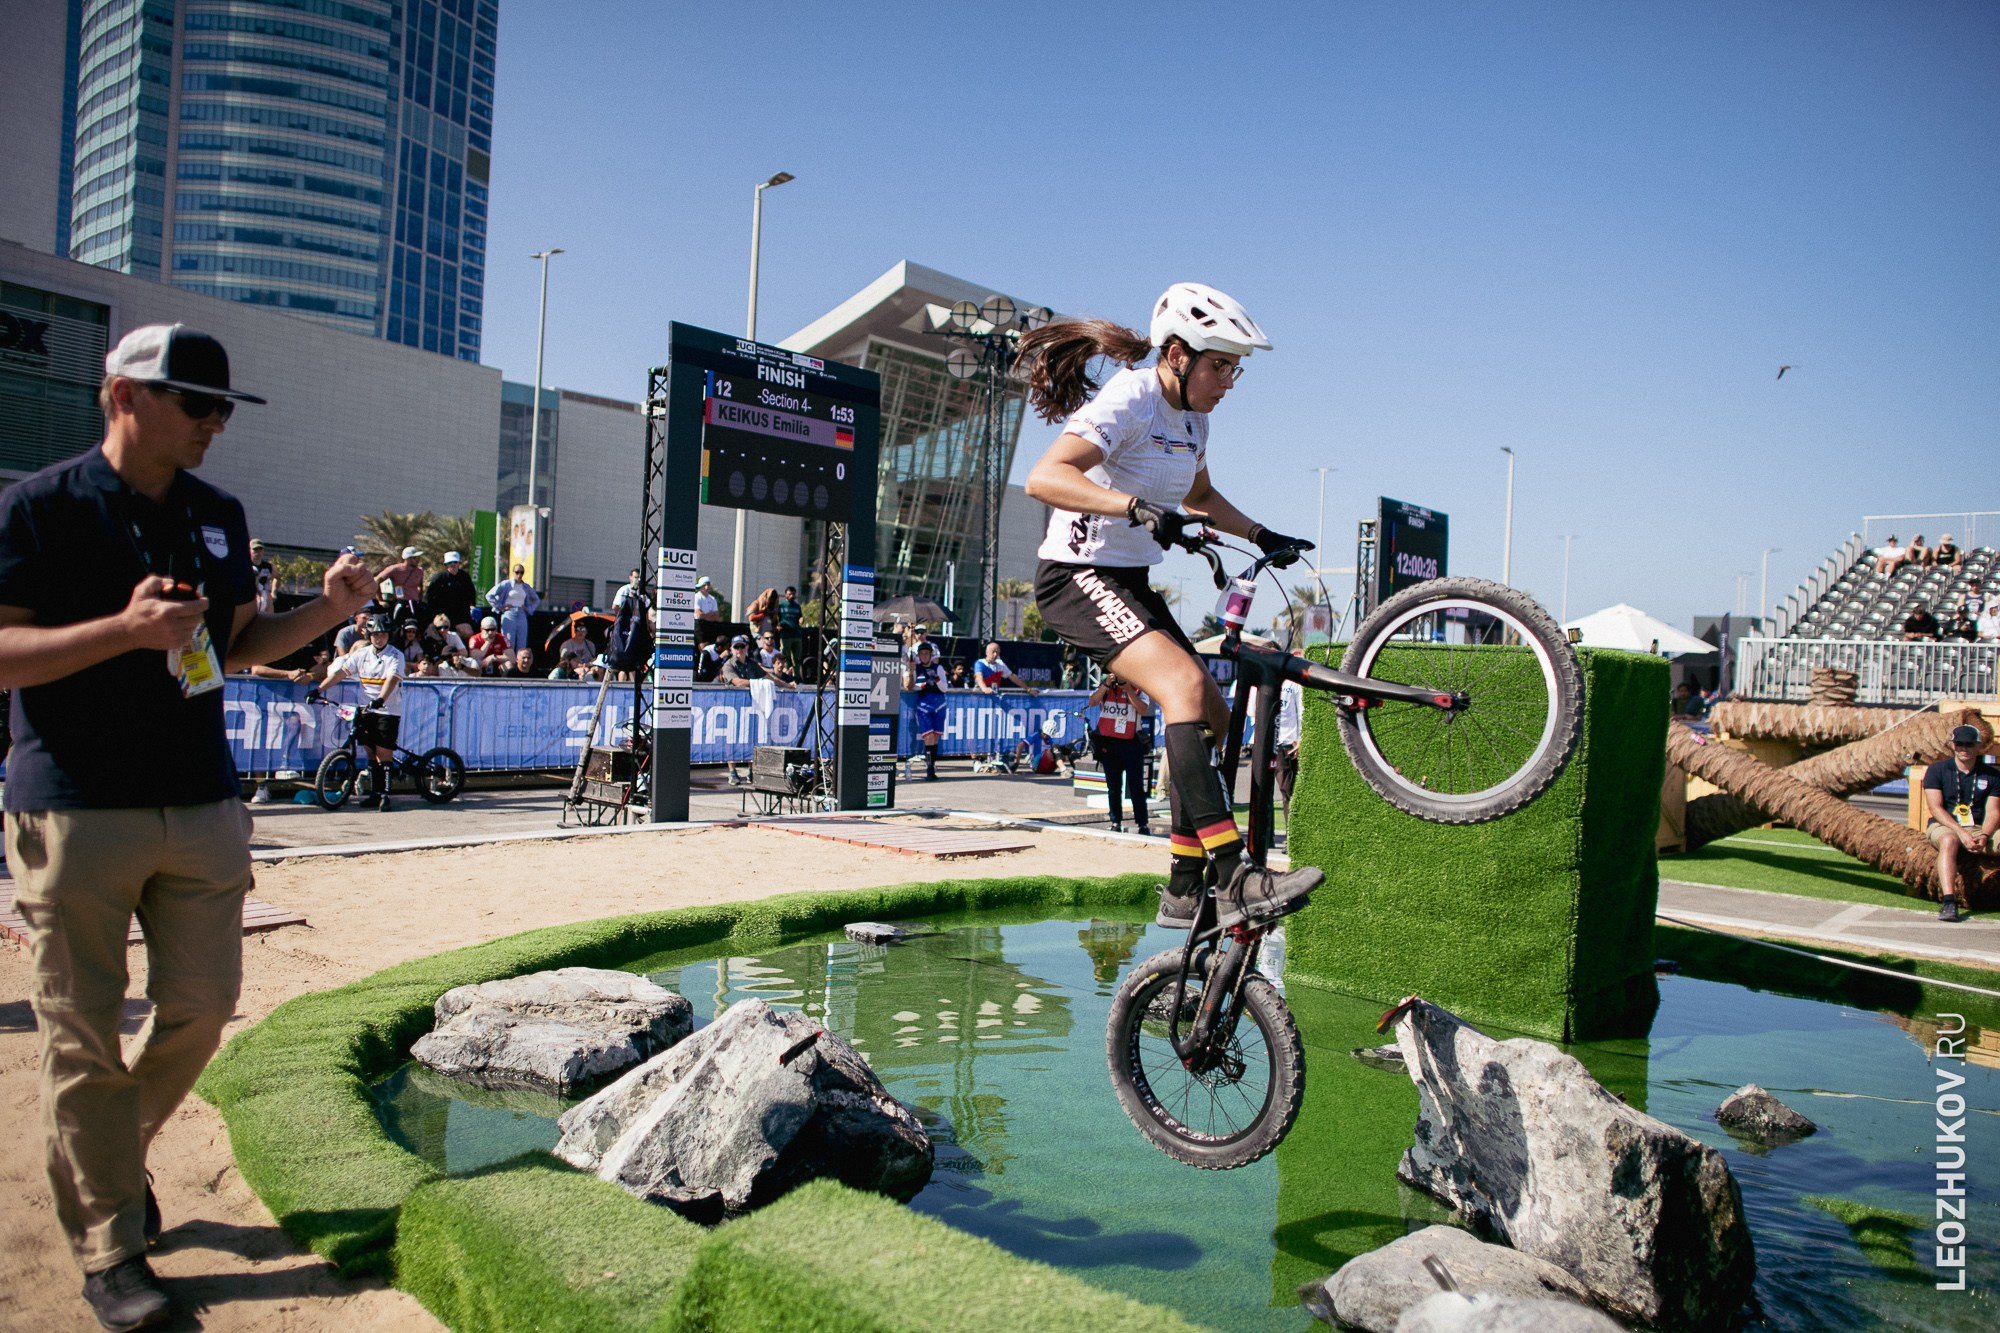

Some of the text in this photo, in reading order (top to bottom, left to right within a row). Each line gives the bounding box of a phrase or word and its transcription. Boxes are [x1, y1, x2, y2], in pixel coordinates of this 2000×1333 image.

[740, 341, 755, 352] UCI
[757, 364, 805, 389] FINISH
[715, 379, 732, 398] 12
[718, 404, 810, 436] KEIKUS Emilia
[830, 405, 854, 423] 1:53
[836, 462, 845, 481] 0
[1408, 516, 1425, 529] FINISH
[471, 545, 483, 582] DHABI
[669, 552, 694, 565] UCI
[1396, 552, 1438, 579] 12:00:26
[848, 569, 874, 578] SHIMANO
[1072, 568, 1146, 639] GERMANY
[1096, 614, 1128, 645] TEAM
[670, 635, 684, 643] UCI
[659, 653, 693, 662] SHIMANO
[845, 658, 871, 666] SHIMANO
[872, 660, 900, 674] NISH
[1017, 668, 1052, 681] ABU DHABI
[665, 693, 689, 704] UCI
[849, 694, 867, 704] UCI
[870, 677, 890, 711] 4
